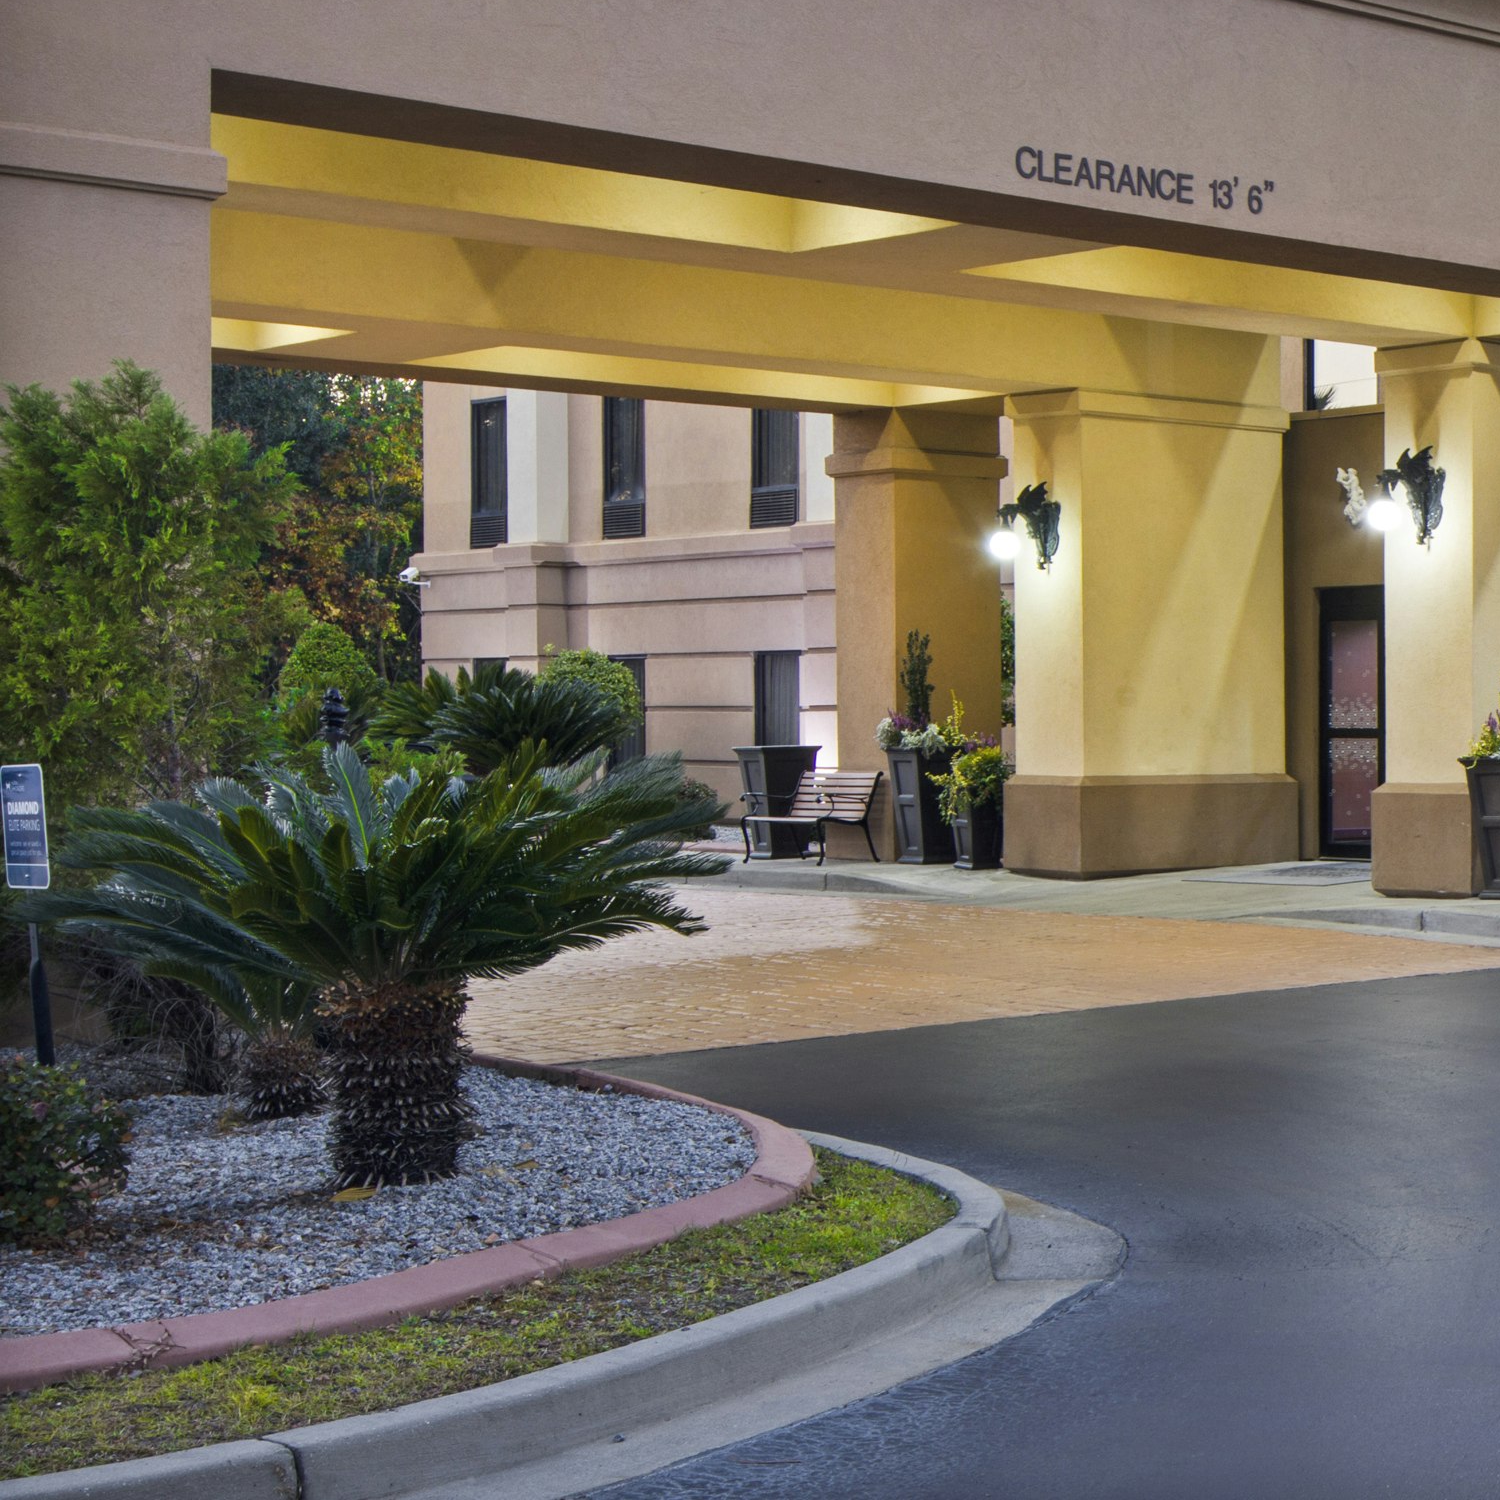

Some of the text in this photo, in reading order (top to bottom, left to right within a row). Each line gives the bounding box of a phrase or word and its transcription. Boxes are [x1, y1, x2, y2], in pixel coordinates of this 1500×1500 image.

[1015, 146, 1194, 204] CLEARANCE
[7, 801, 39, 816] DIAMOND
[8, 819, 41, 832] ELITE PARKING
